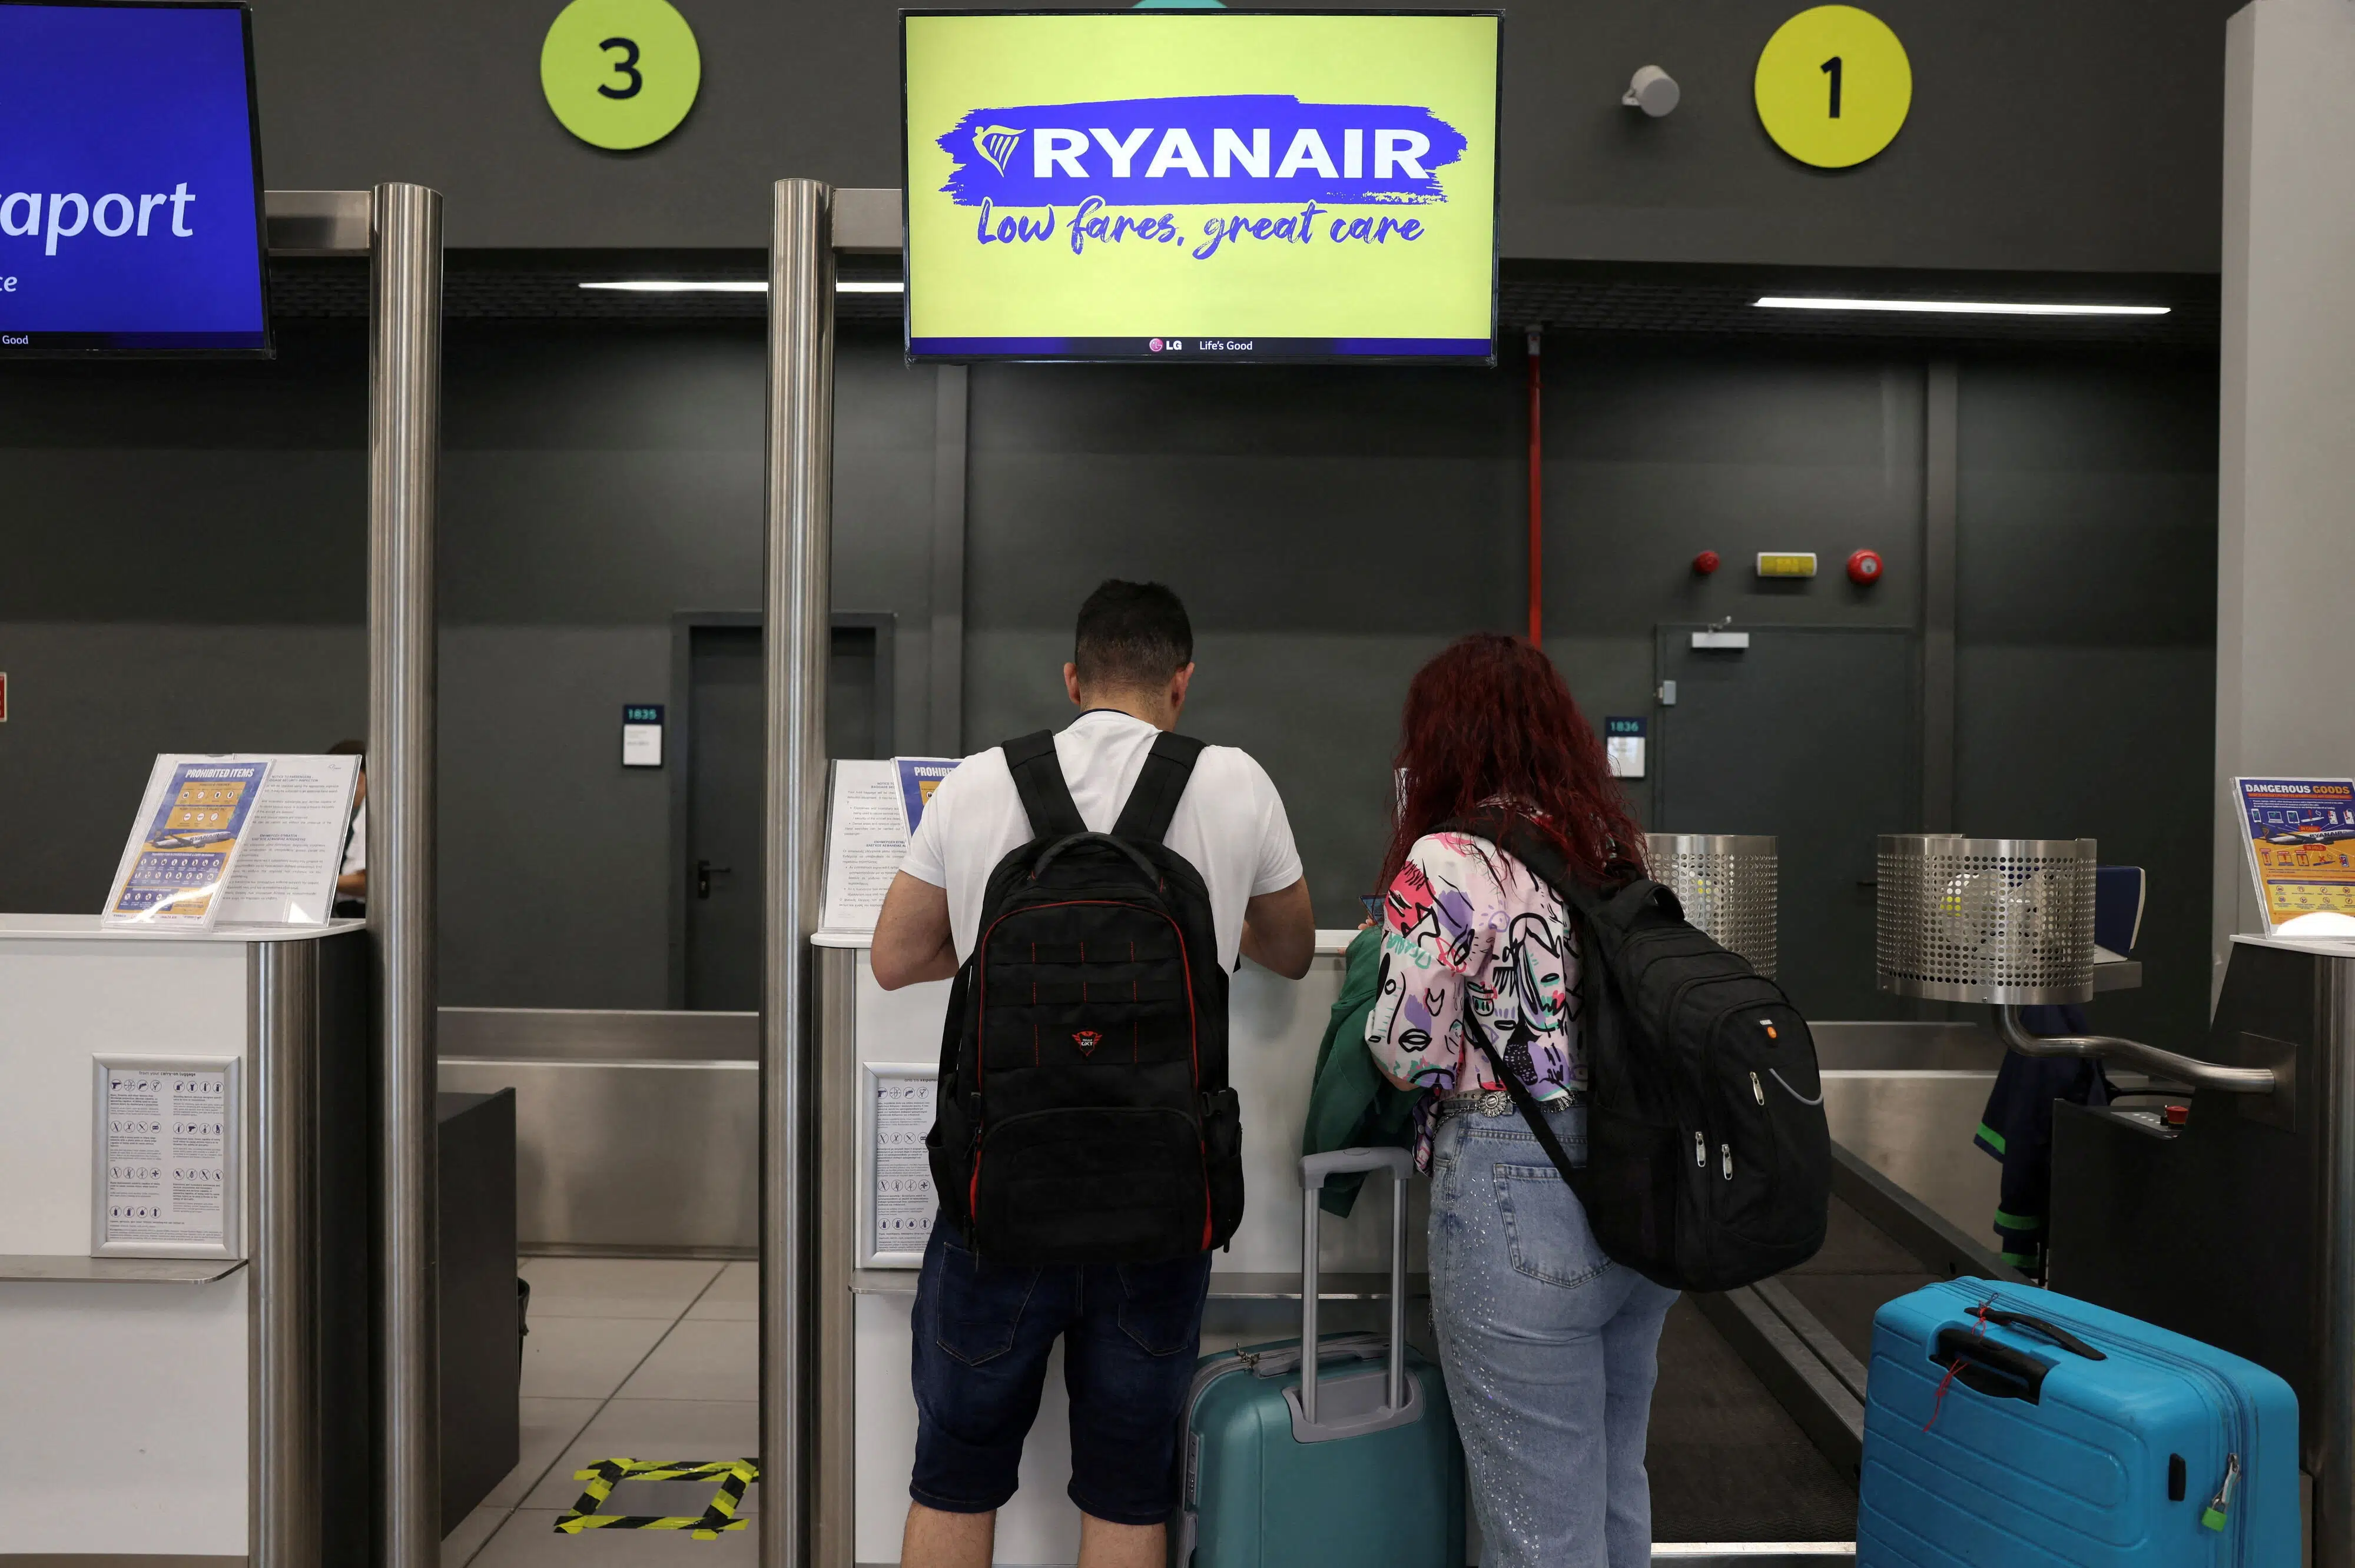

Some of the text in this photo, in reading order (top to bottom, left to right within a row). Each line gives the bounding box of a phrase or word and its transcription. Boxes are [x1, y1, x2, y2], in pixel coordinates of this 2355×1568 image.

[598, 37, 642, 100] 3
[1820, 57, 1842, 119] 1
[1034, 128, 1431, 179] RYANAIR
[0, 182, 195, 256] aport
[977, 198, 1425, 260] Low fares, great care
[2, 335, 29, 344] Good
[1166, 340, 1182, 351] LG
[1226, 341, 1253, 351] Good
[1610, 721, 1639, 732] 1836
[185, 768, 255, 778] PROHIBITED ITEMS
[2245, 784, 2350, 794] DANGEROUS GOODS
